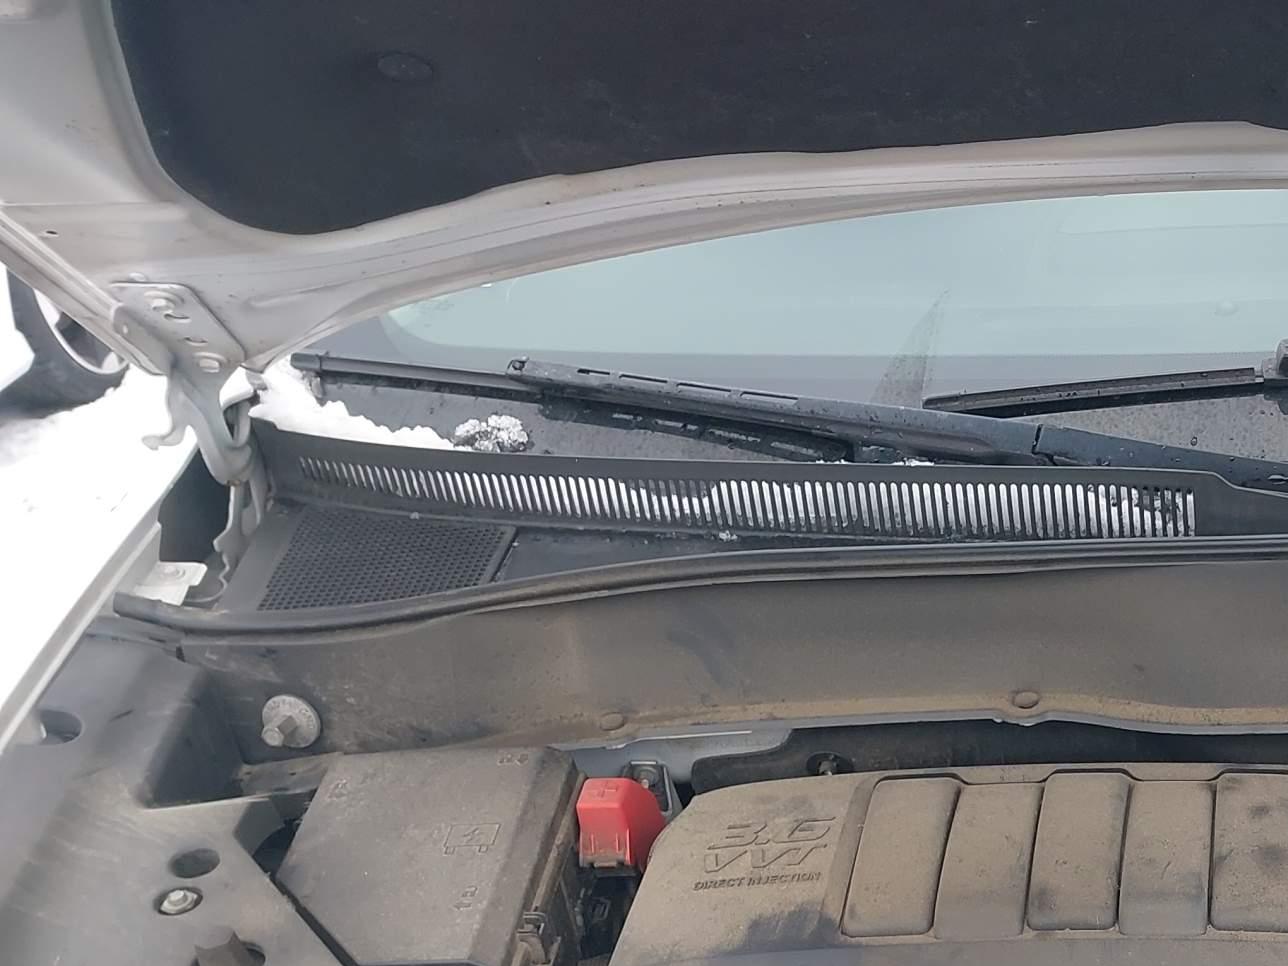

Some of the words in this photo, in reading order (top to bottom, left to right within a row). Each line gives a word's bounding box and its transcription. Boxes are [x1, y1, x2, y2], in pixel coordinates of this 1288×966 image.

[707, 816, 836, 850] 3.6
[703, 843, 829, 874] VVT
[693, 876, 746, 892] DIRECT
[747, 872, 822, 887] INJECTION
